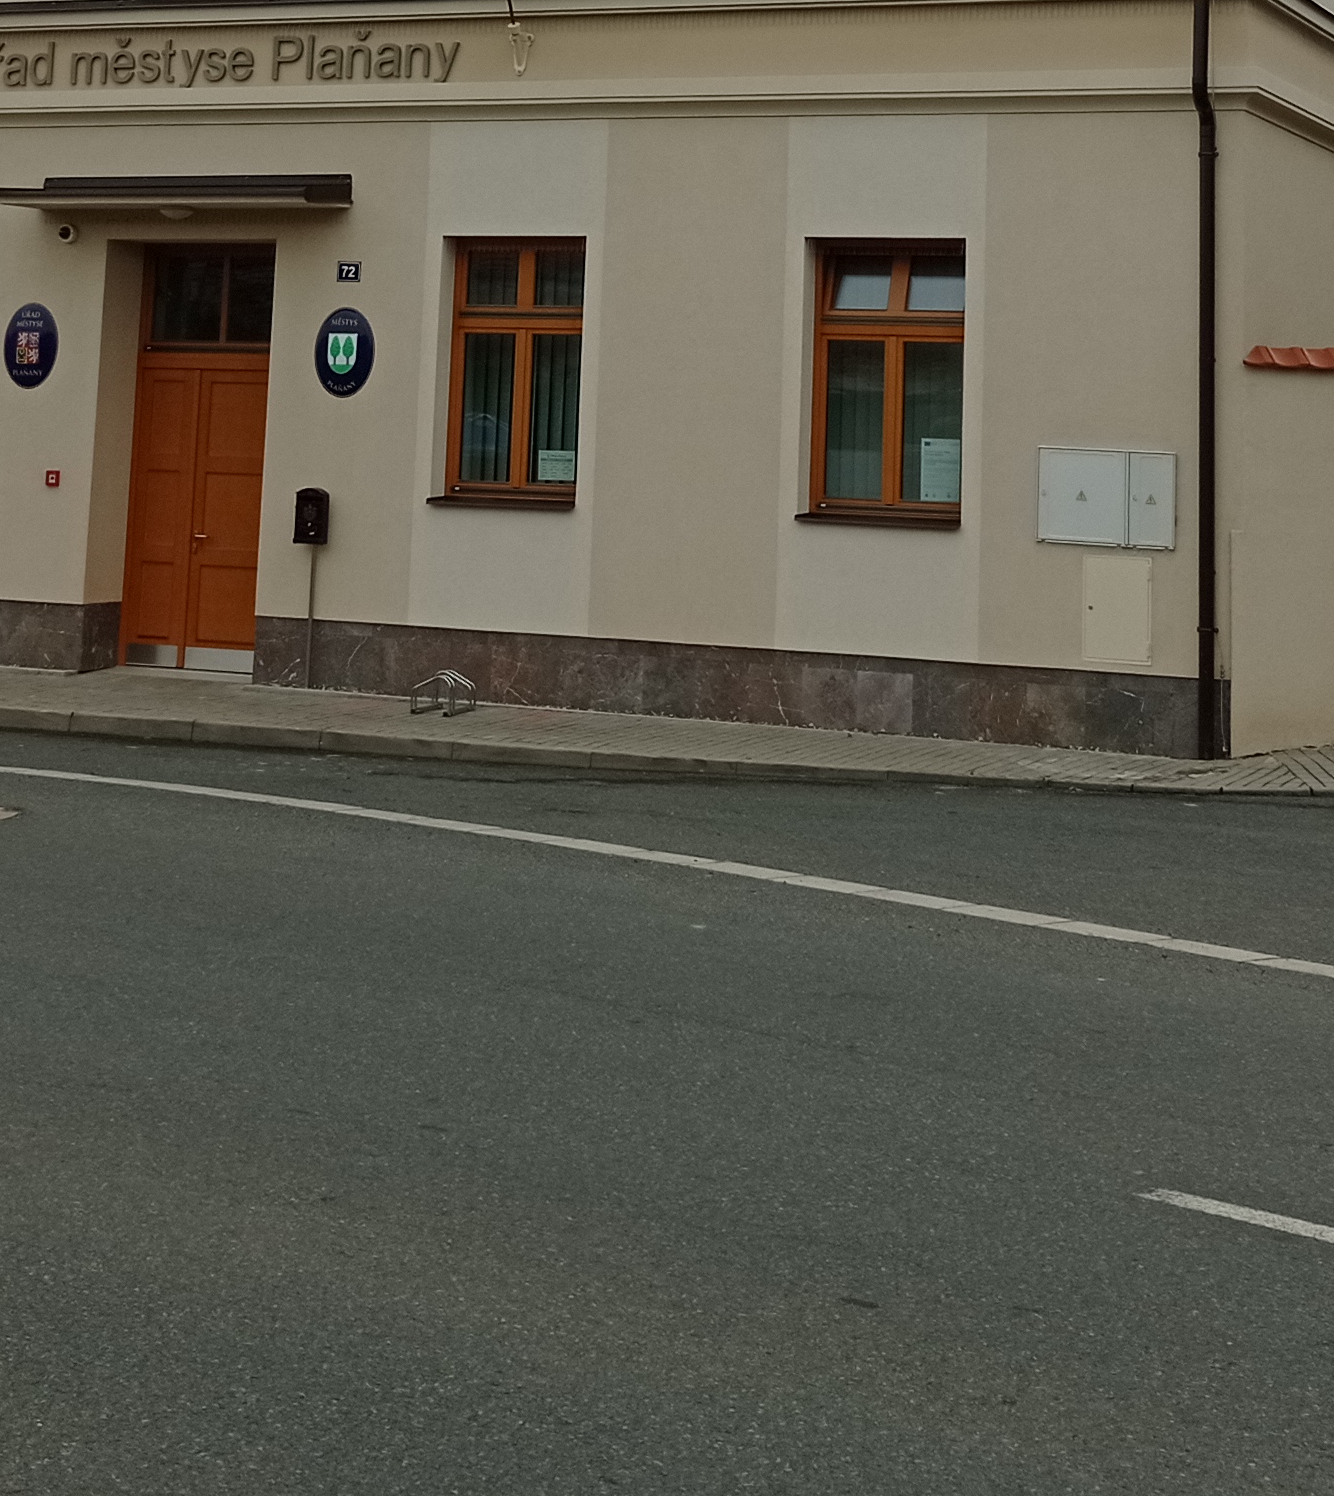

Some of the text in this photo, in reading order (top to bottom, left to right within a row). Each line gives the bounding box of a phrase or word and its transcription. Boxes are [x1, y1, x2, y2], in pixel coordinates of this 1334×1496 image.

[70, 37, 255, 88] městyse
[271, 30, 461, 83] Plaňany
[341, 265, 356, 278] 72
